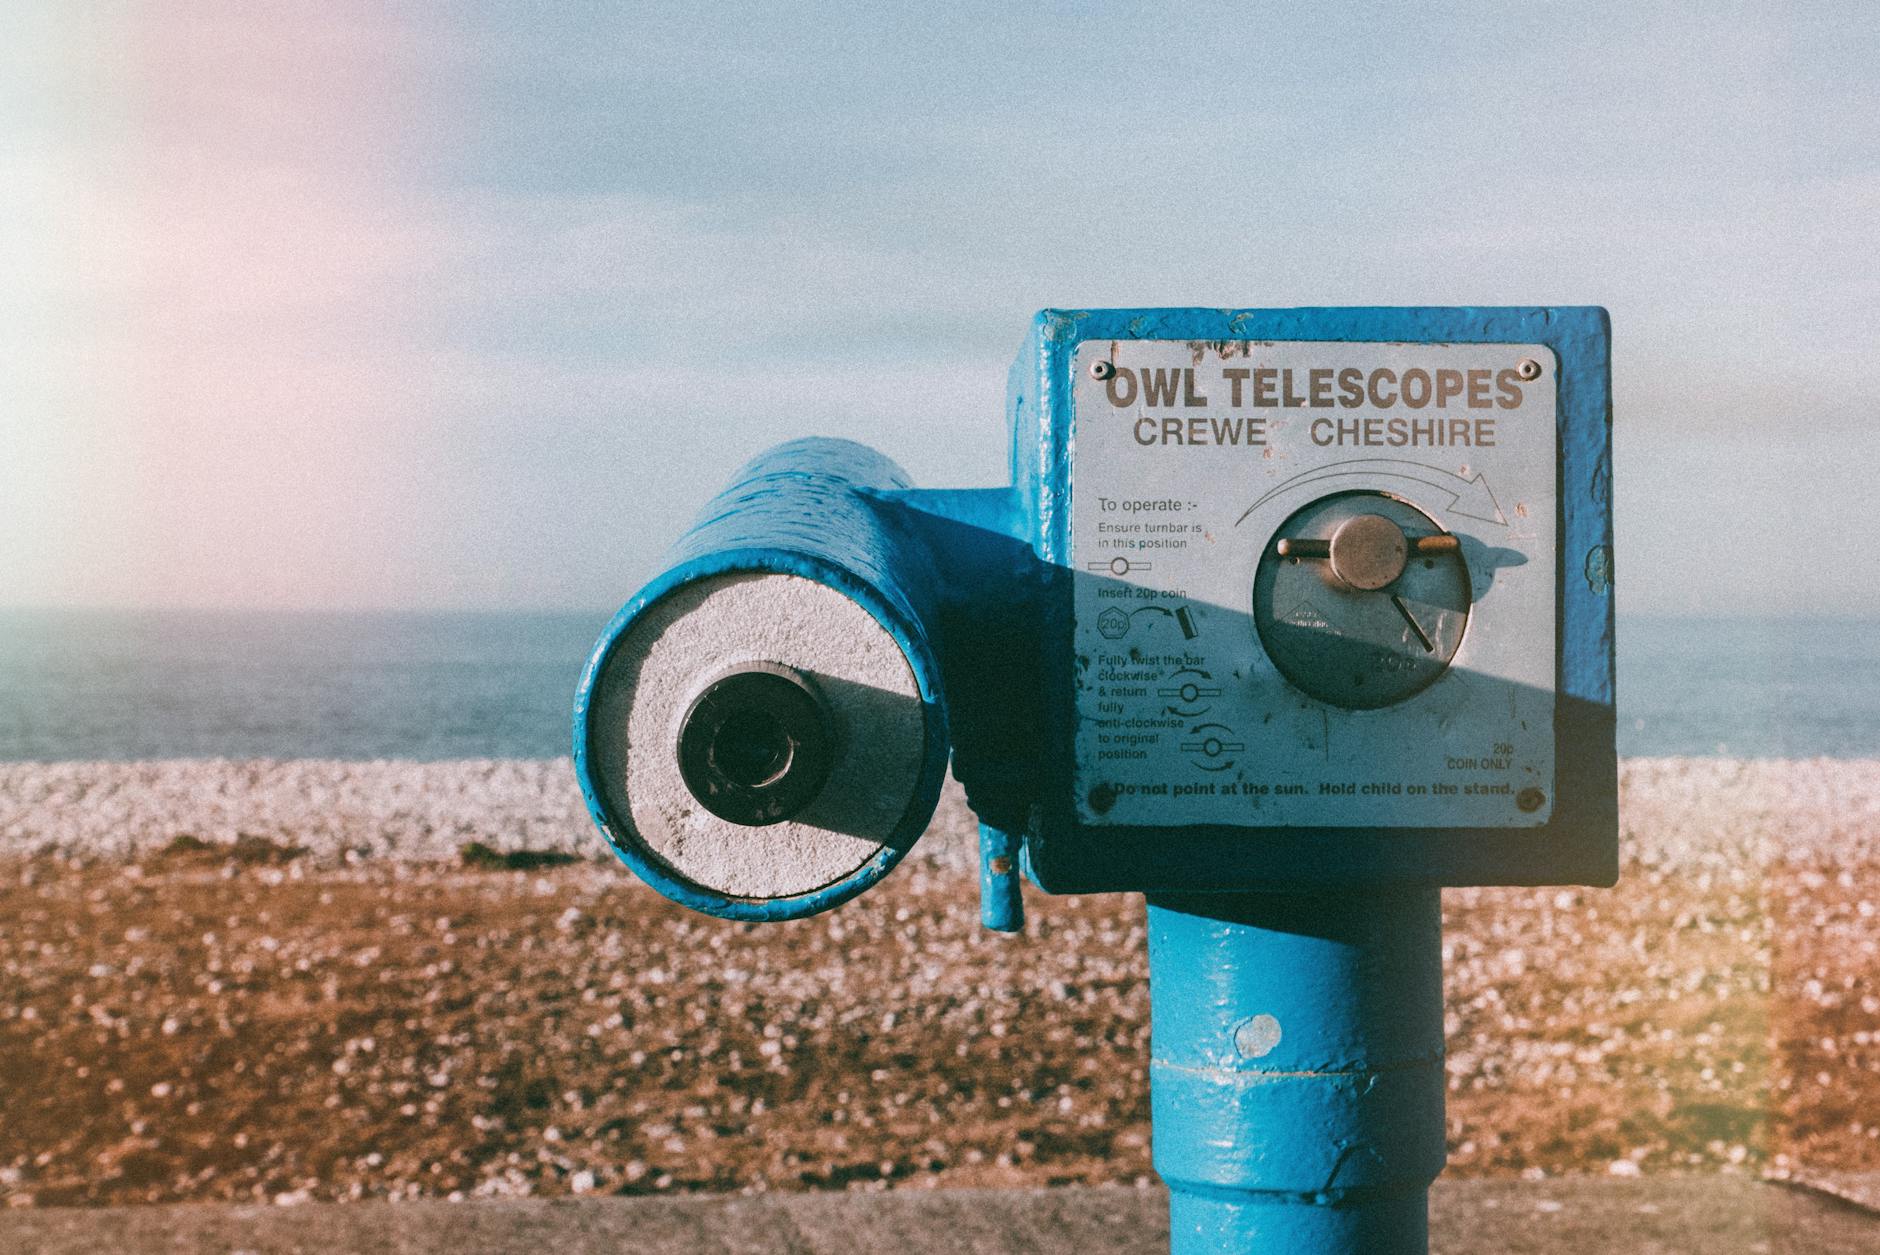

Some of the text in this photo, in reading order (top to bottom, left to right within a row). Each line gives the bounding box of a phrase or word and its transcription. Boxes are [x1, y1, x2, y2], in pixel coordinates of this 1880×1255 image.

[1105, 366, 1524, 410] OWL TELESCOPES
[1133, 417, 1496, 447] CREWE CHESHIRE
[1098, 498, 1117, 511] To
[1122, 498, 1182, 514] operate
[1098, 523, 1202, 533] Ensure turnbar is
[1098, 538, 1187, 550] in this position
[1098, 588, 1187, 600] Insert 20p coin
[1102, 618, 1125, 630] 20p
[1098, 654, 1205, 668] Fully twist the bar
[1098, 670, 1158, 681] clockwise
[1098, 687, 1147, 697] & return
[1098, 703, 1124, 714] fully
[1098, 718, 1184, 728] anti-clockwise
[1098, 733, 1159, 746] to original
[1098, 749, 1147, 761] position
[1493, 742, 1514, 756] 20p
[1447, 757, 1512, 770] COIN ONLY
[1114, 783, 1516, 797] Do not point at the sun. Hold child on the stand.
